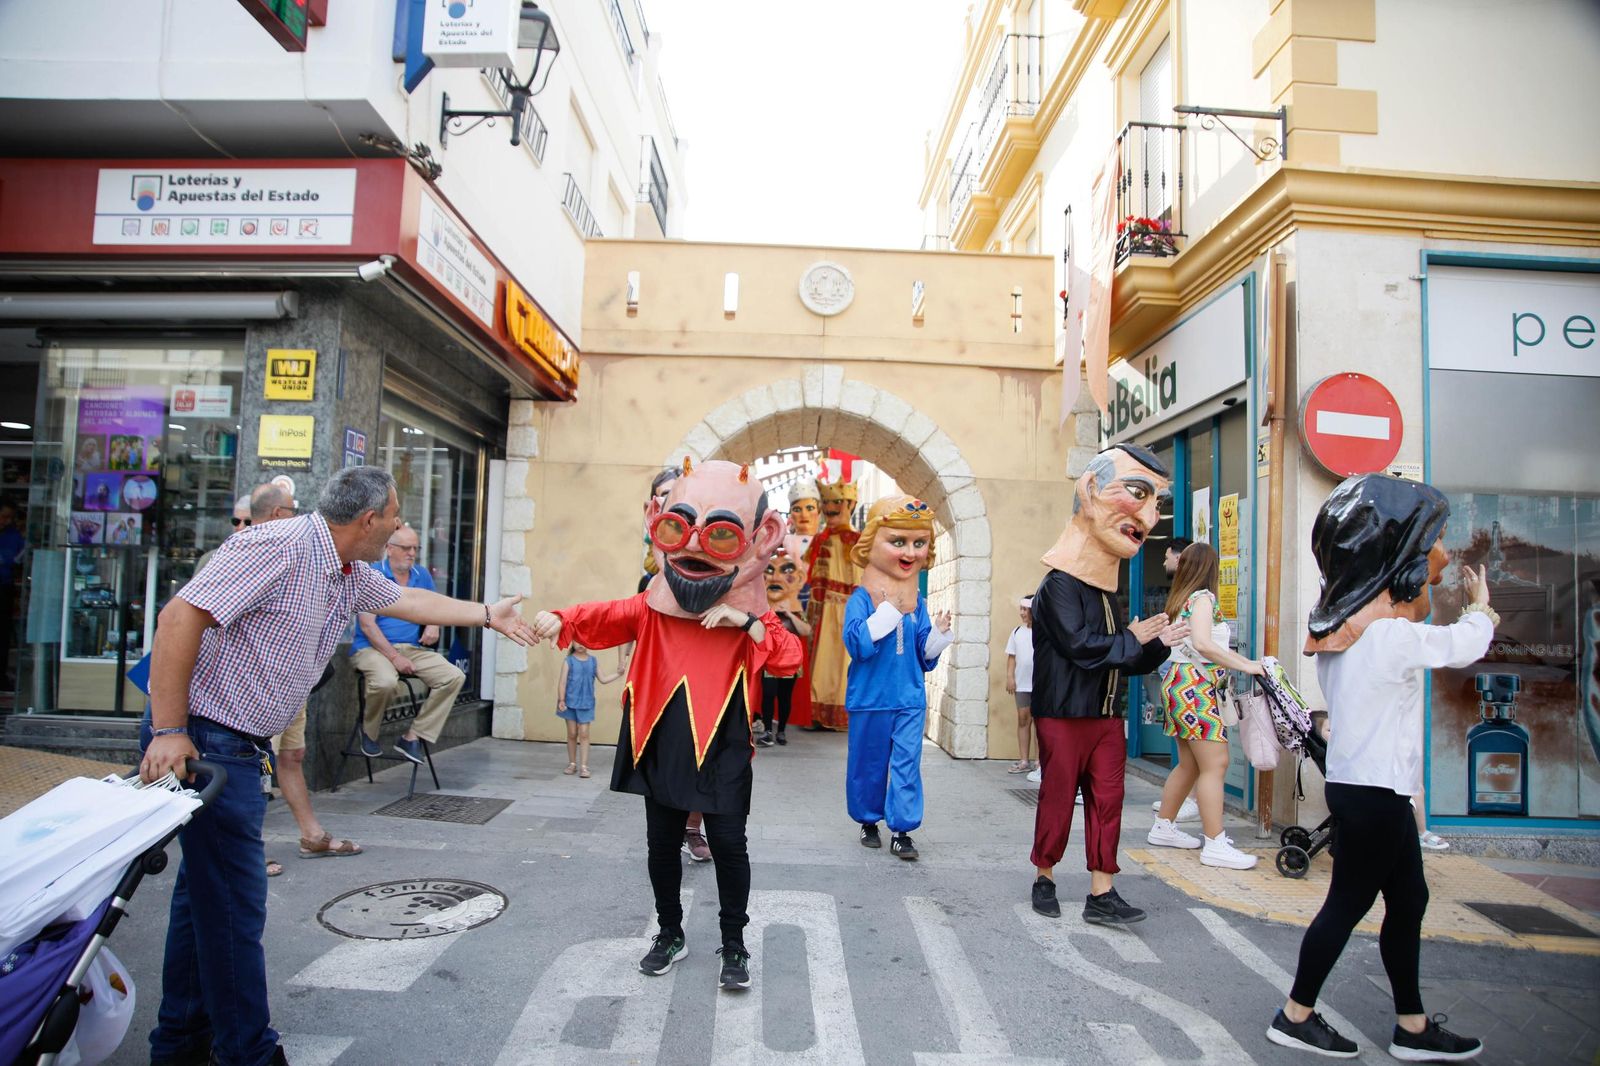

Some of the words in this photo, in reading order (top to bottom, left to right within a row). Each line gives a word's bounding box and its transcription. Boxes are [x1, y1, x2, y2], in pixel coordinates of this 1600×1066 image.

[168, 173, 228, 186] Loterías
[233, 177, 242, 188] y
[168, 190, 236, 204] Apuestas
[241, 190, 264, 202] del
[268, 190, 320, 202] Estado
[279, 428, 307, 437] inPost
[262, 459, 286, 467] Punto
[287, 459, 306, 467] Pack
